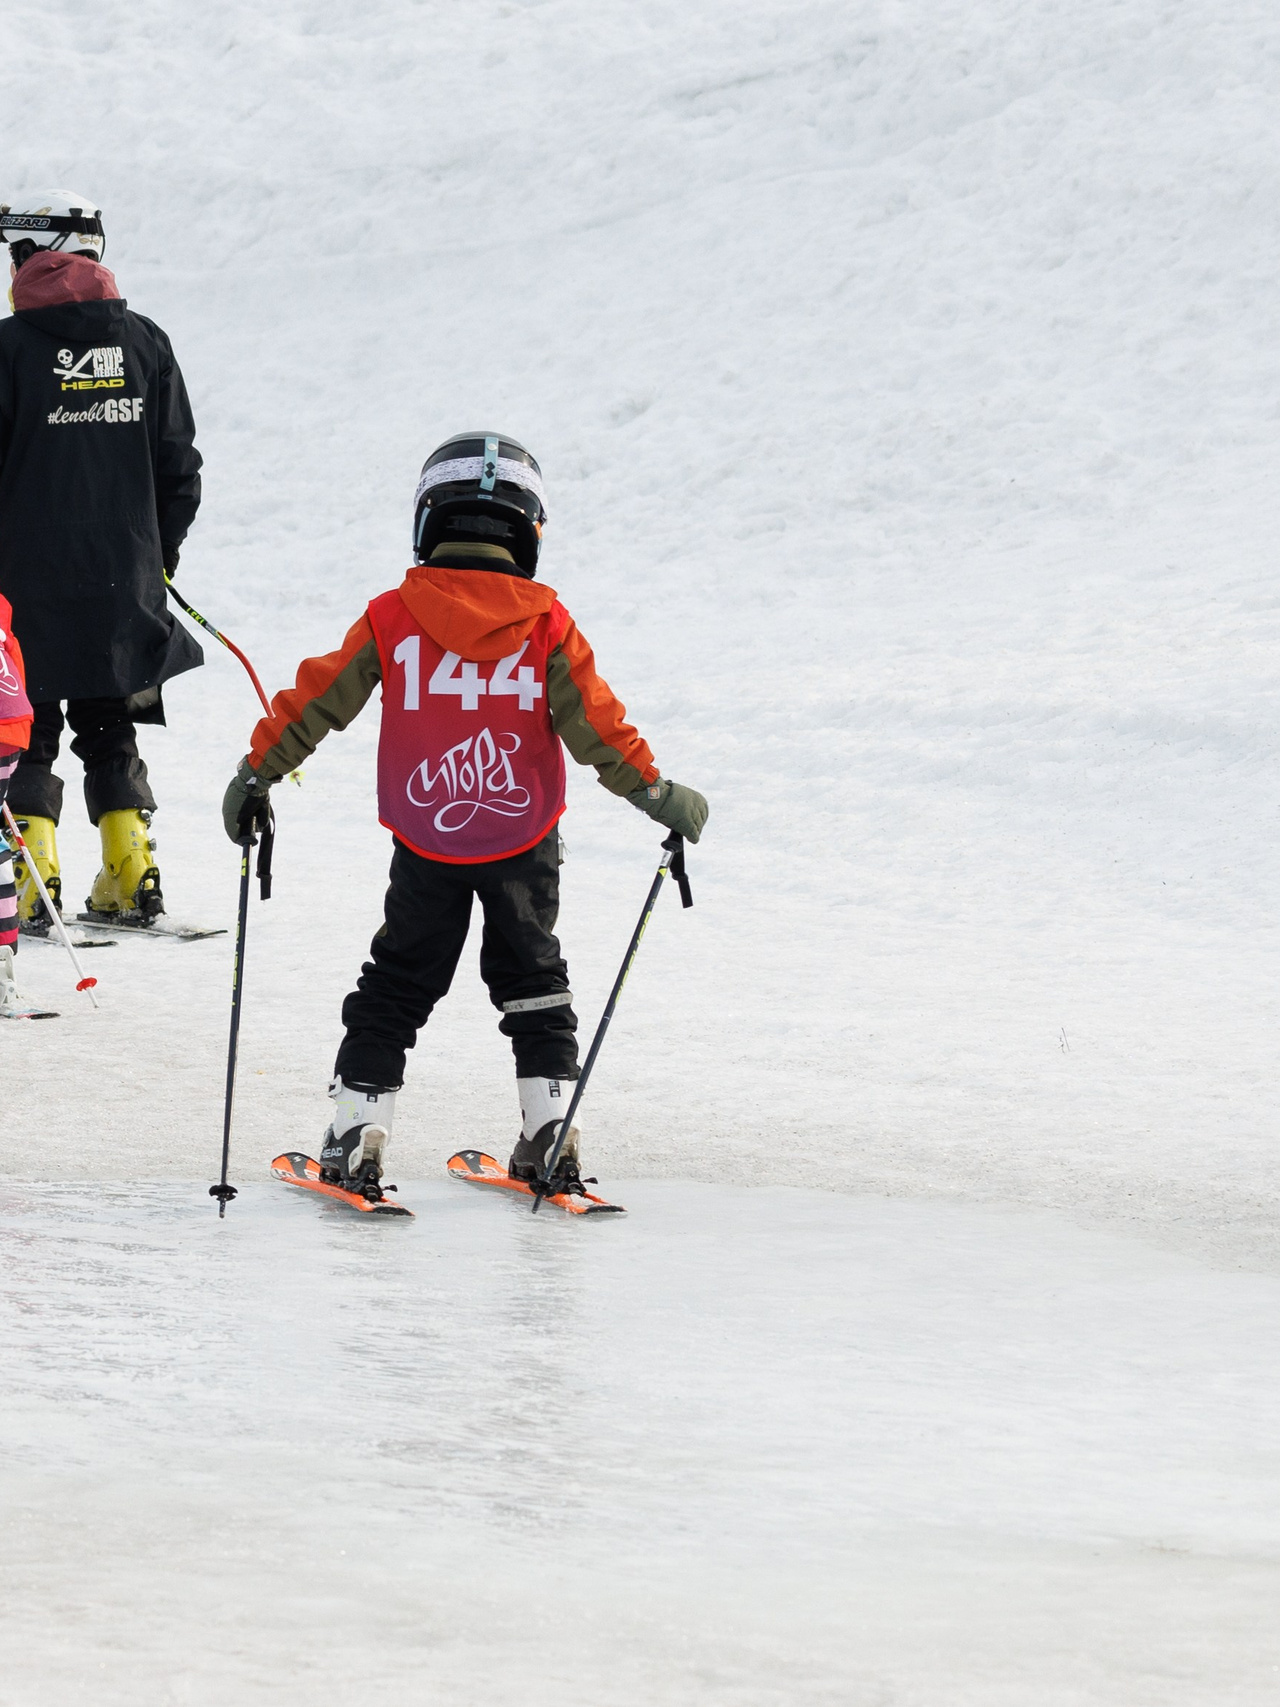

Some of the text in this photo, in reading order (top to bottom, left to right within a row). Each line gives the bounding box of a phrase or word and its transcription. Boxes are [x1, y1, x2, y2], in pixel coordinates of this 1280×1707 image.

[93, 355, 124, 370] CUP
[61, 379, 125, 391] HEAD
[393, 635, 543, 712] 144
